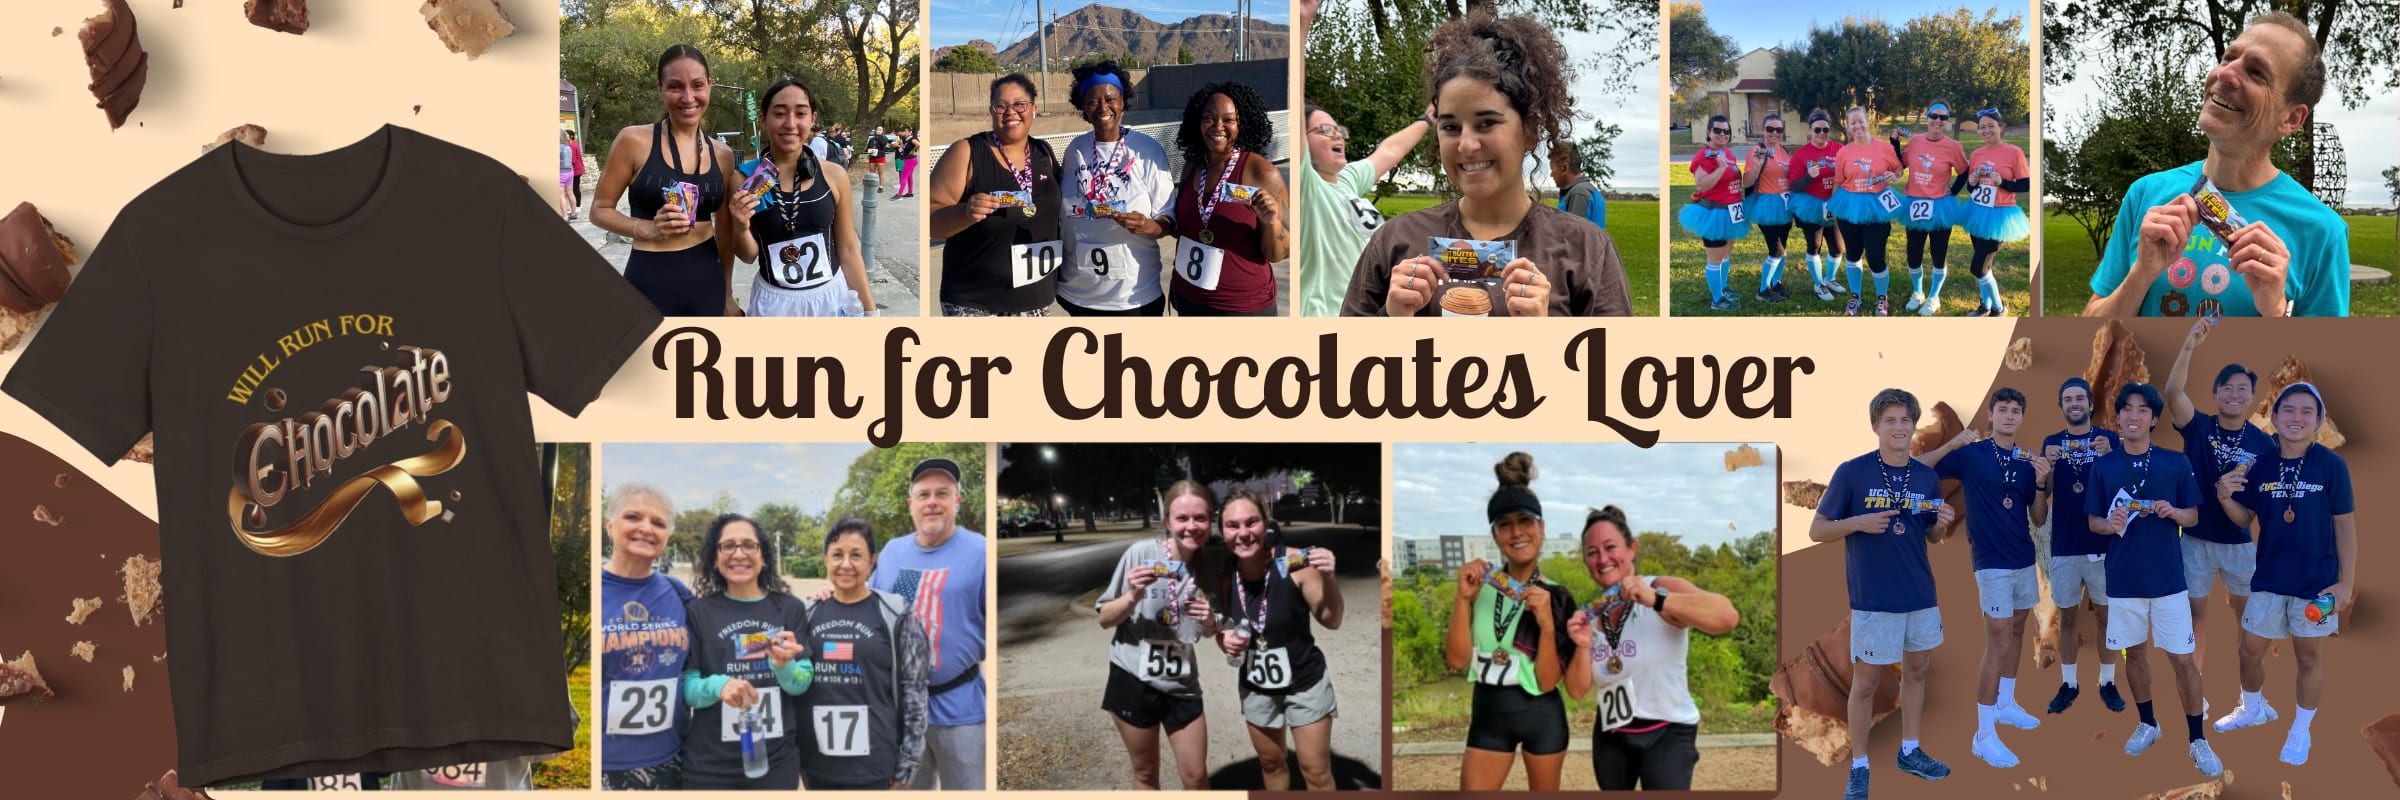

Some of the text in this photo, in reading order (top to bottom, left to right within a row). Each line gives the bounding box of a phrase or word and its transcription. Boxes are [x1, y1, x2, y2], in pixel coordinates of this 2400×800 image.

[1912, 202, 1930, 219] 22
[1973, 187, 1992, 205] 28
[779, 241, 824, 285] 82
[1021, 245, 1055, 281] 10
[1091, 248, 1109, 276] 9
[1186, 246, 1205, 281] 8
[226, 313, 395, 406] WILL RUN FOR
[641, 620, 678, 632] SERIES
[718, 619, 760, 638] FREEDOM
[812, 619, 875, 639] FREEDOM RUN
[727, 660, 770, 673] RUN US
[815, 662, 863, 676] RUN USA
[1147, 643, 1182, 678] 55
[1251, 652, 1284, 685] 56
[619, 685, 669, 729] 23
[1603, 685, 1633, 725] 20
[822, 710, 860, 751] 17
